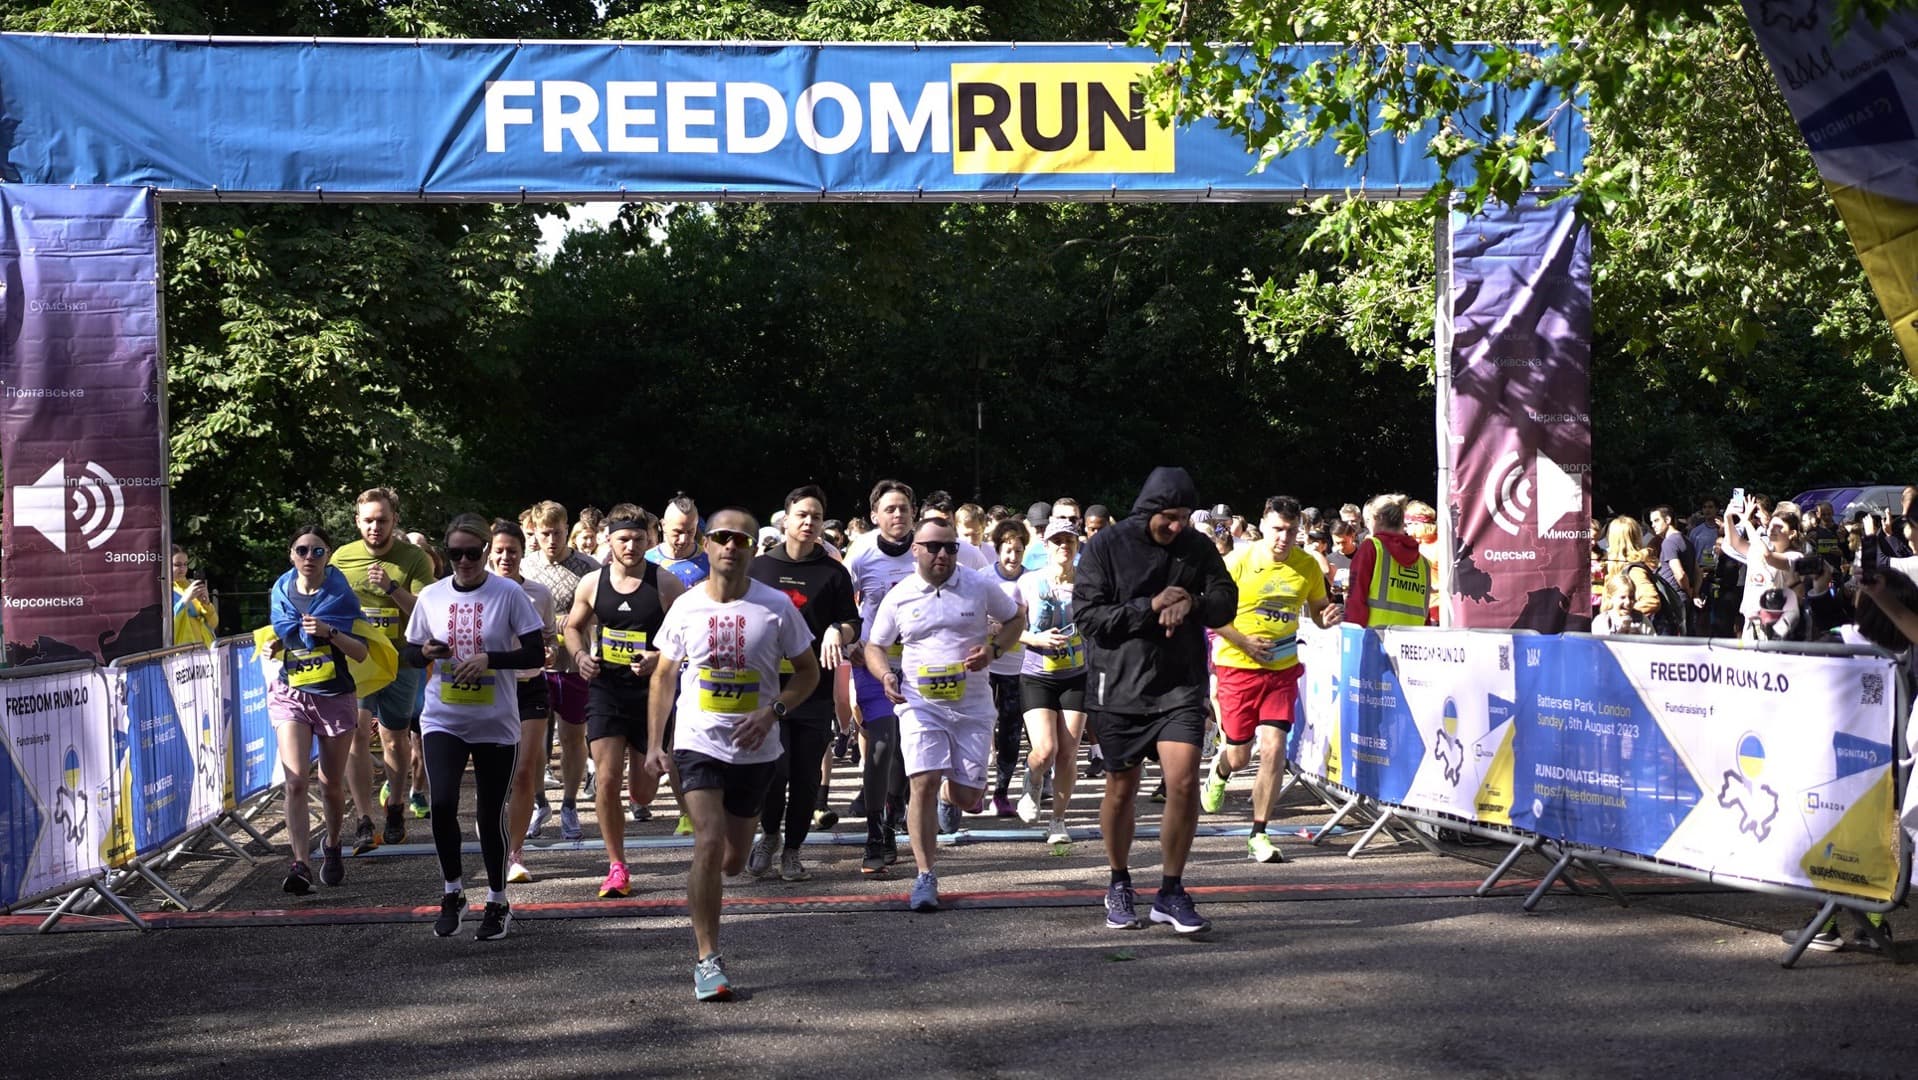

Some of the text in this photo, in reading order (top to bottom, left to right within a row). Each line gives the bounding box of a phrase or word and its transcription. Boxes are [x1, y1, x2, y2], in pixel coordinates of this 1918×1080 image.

[485, 80, 1147, 154] FREEDOM RUN
[6, 387, 85, 398] Полтавська
[1528, 411, 1589, 423] Черкаська
[1484, 549, 1536, 562] Одеська
[1390, 577, 1425, 595] TIMING
[4, 595, 84, 609] Херсонська
[610, 639, 635, 654] 278
[1726, 666, 1759, 690] RUN
[1761, 671, 1789, 693] 2.0
[712, 682, 744, 700] 227
[6, 687, 89, 717] FREEDOM RUN 2.0
[1537, 694, 1631, 718] Battersea Park, London
[1664, 702, 1707, 718] Fundraising
[1584, 718, 1614, 736] August
[1617, 723, 1639, 738] 2023
